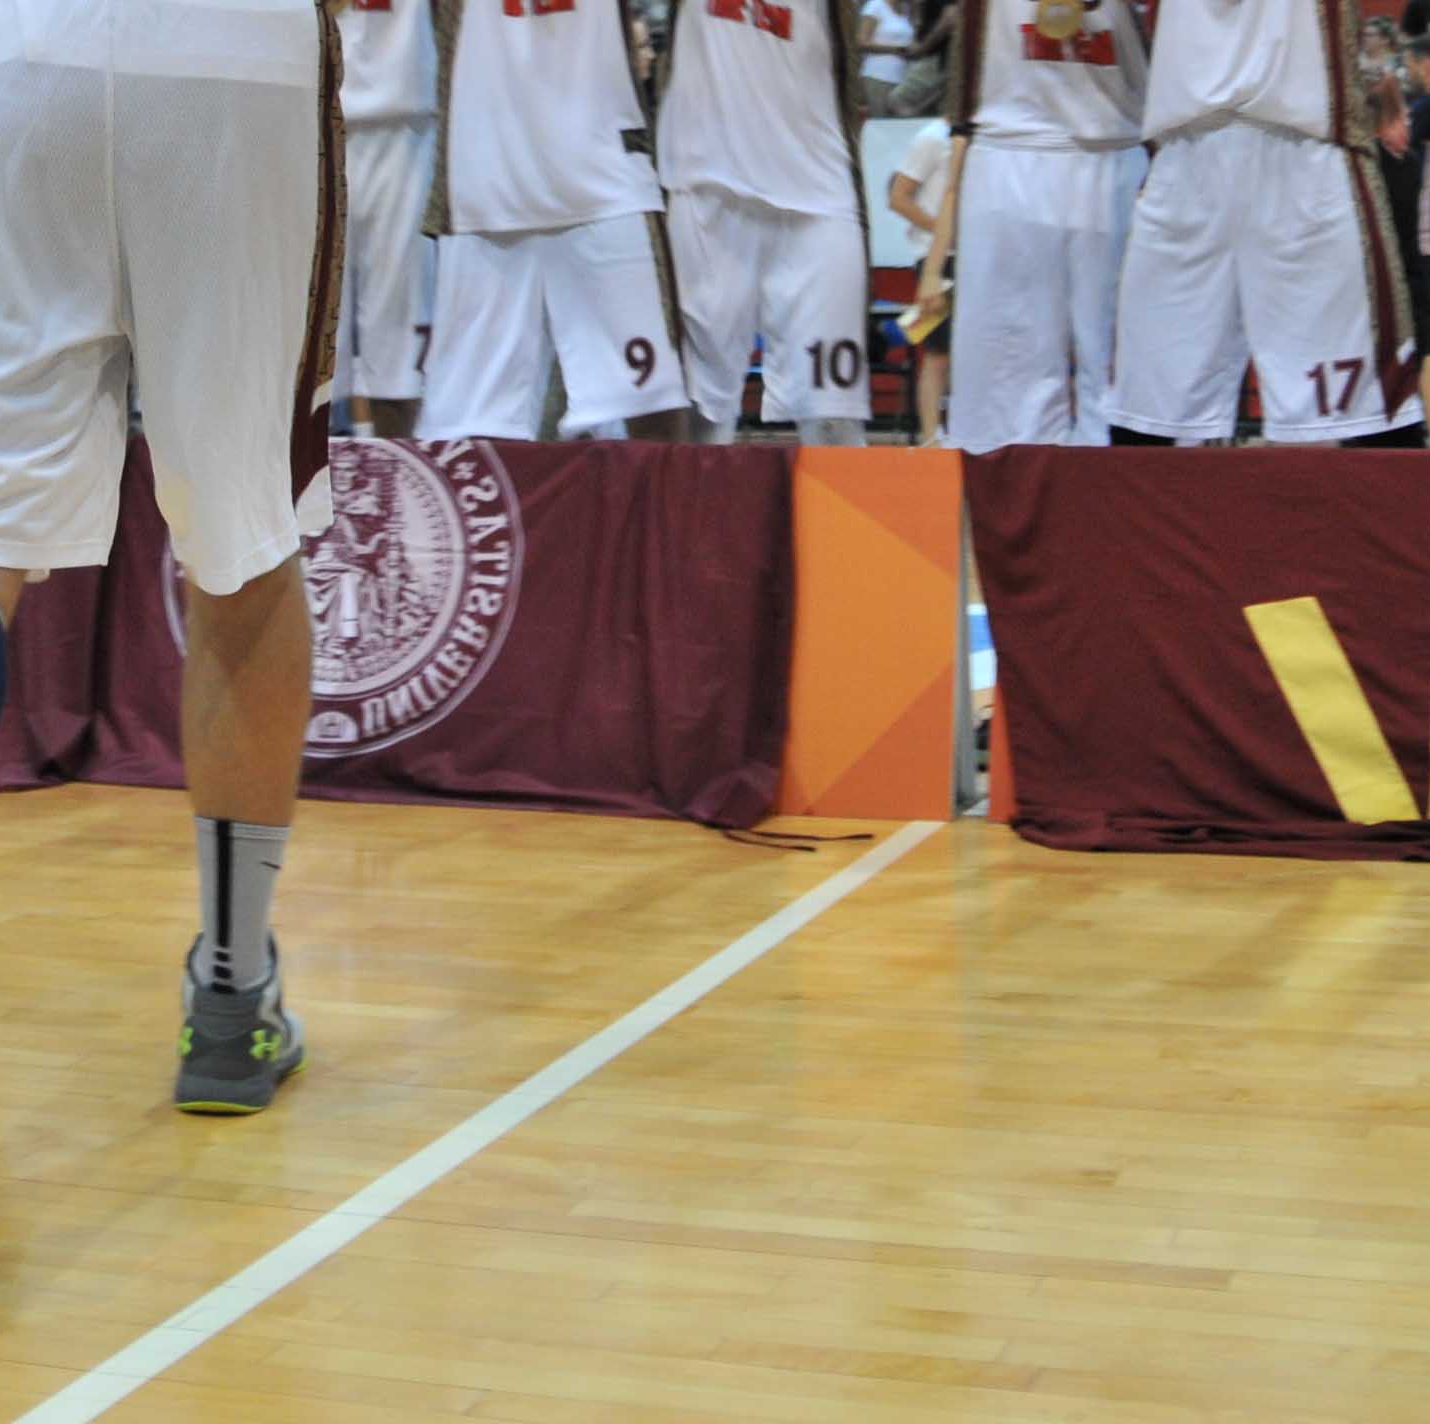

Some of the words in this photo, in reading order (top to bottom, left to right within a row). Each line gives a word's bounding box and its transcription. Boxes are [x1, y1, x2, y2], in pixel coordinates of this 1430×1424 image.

[625, 338, 656, 387] 9
[806, 339, 861, 389] 10
[1307, 358, 1365, 415] 17
